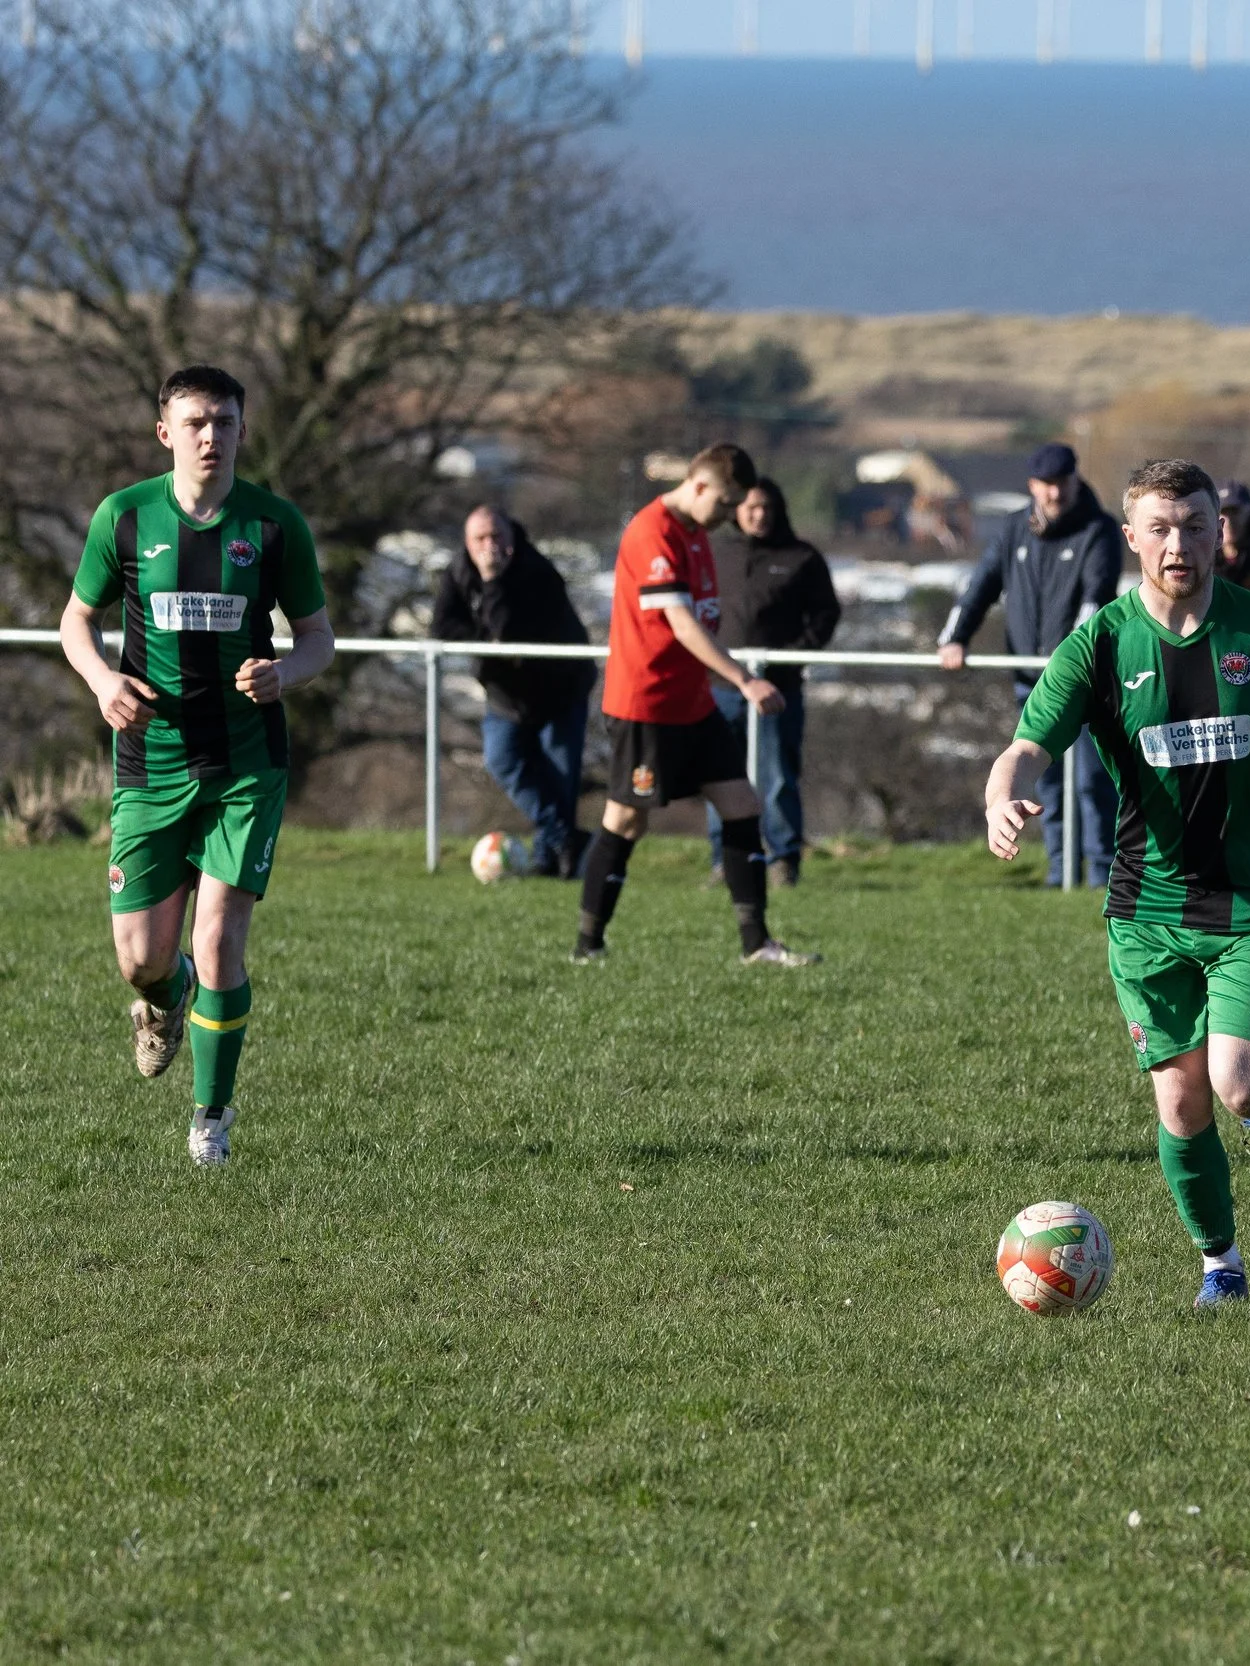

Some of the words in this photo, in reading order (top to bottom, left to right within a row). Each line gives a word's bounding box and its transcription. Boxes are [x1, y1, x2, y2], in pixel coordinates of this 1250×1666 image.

[176, 595, 234, 608] Lakeland
[176, 607, 242, 619] Verandahs
[1169, 720, 1236, 739] Lakeland
[1171, 733, 1249, 752] Verandahs
